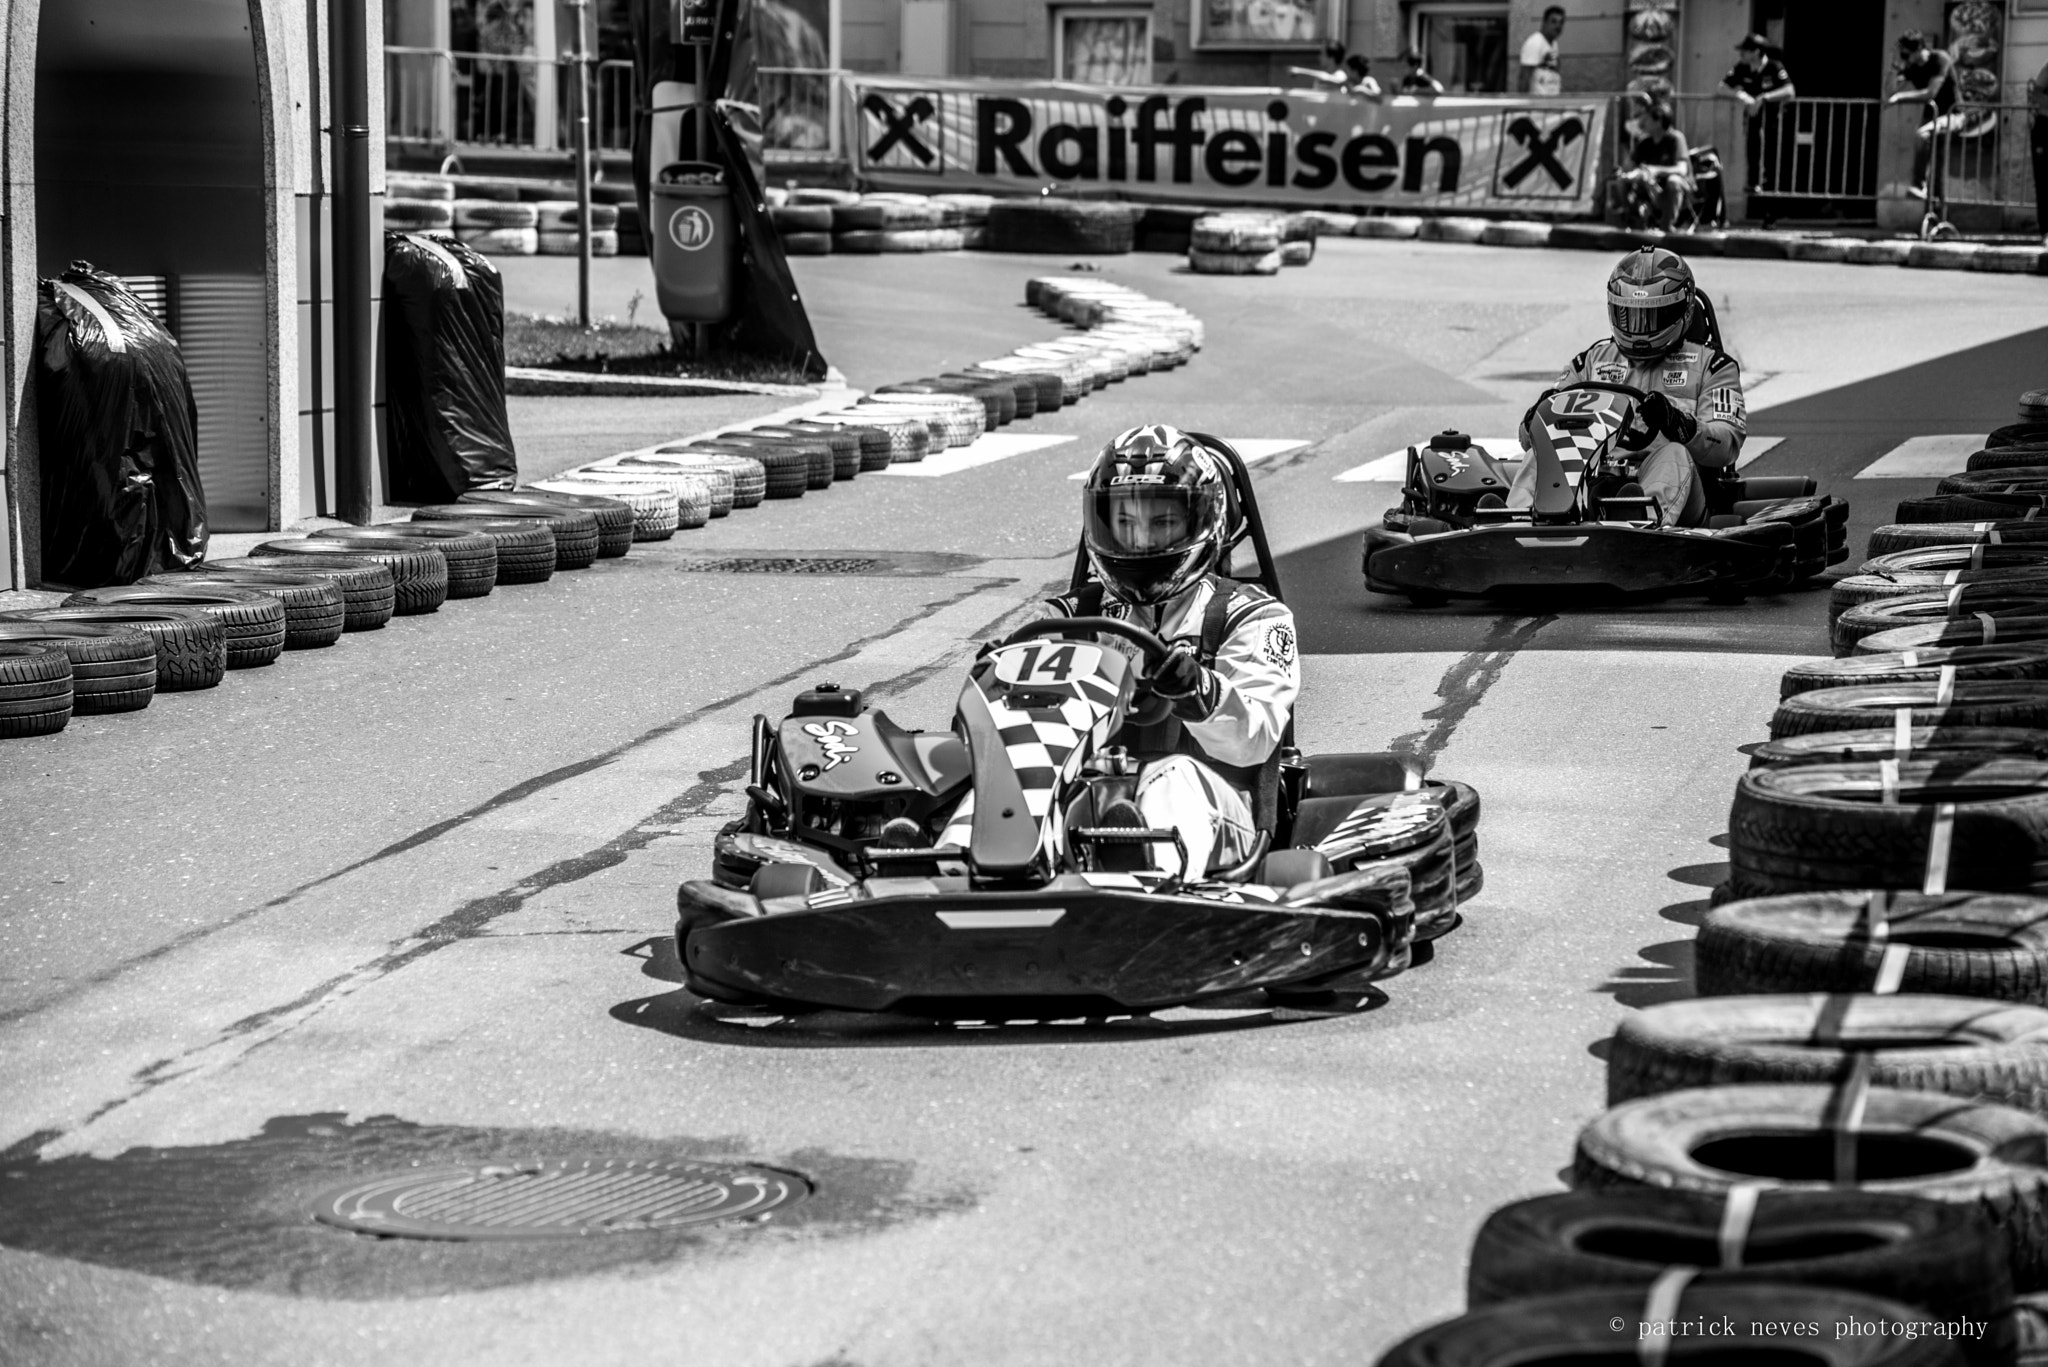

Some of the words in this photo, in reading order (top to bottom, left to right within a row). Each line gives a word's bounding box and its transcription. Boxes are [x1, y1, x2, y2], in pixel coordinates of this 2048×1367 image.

[975, 95, 1462, 194] Raiffeisen
[1563, 392, 1600, 414] 12
[1016, 646, 1076, 682] 14
